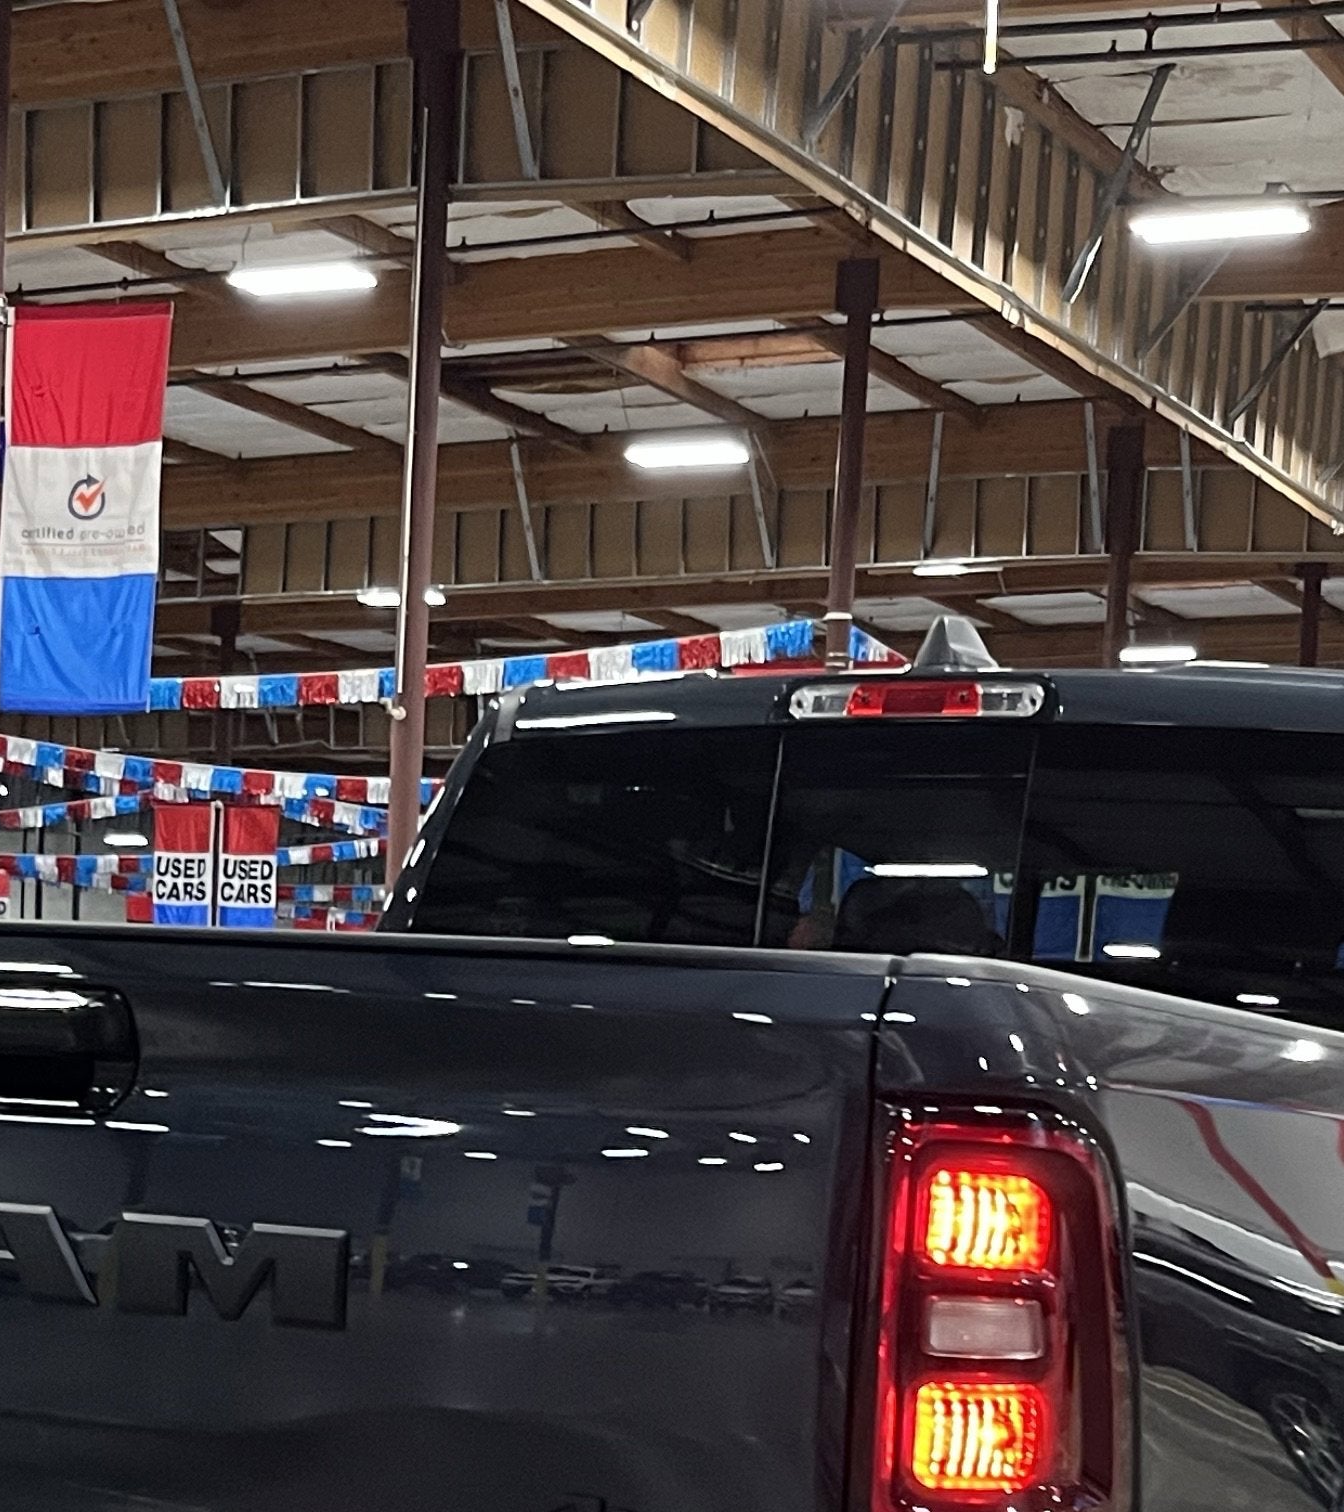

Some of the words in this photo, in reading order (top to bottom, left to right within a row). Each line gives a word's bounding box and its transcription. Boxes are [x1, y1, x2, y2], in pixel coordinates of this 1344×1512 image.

[156, 856, 206, 879] USED
[223, 859, 273, 881] USED
[156, 879, 206, 902] CARS
[221, 882, 272, 904] CARS
